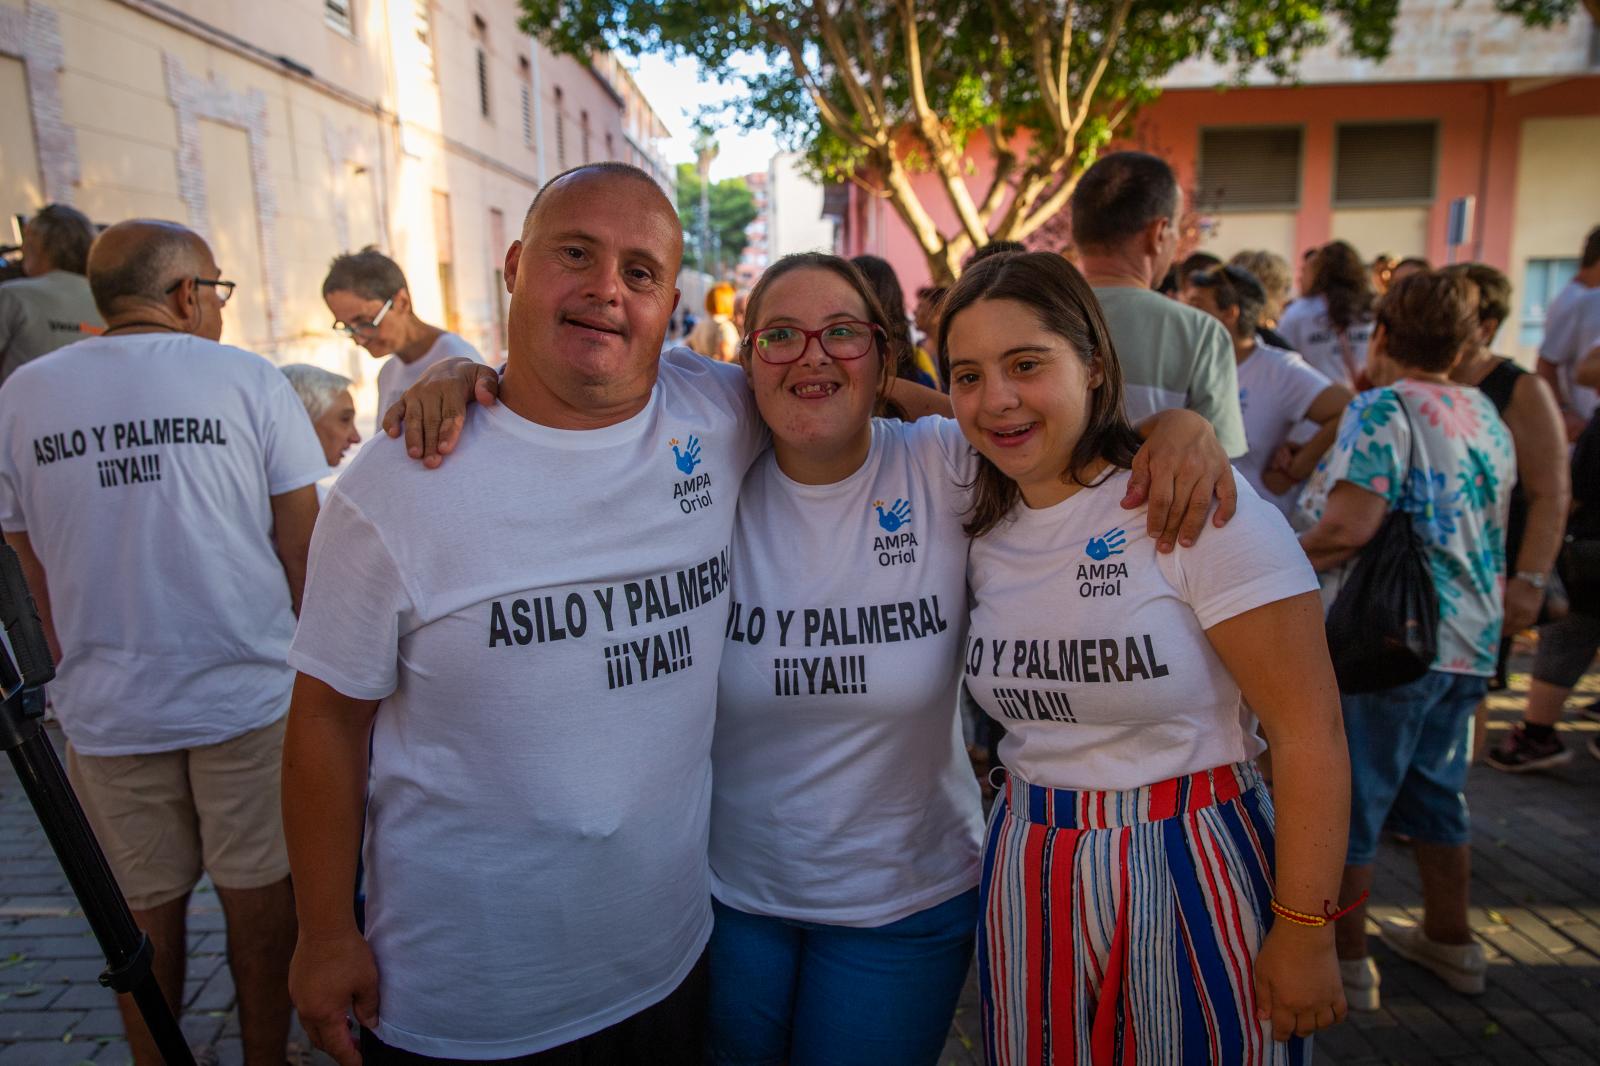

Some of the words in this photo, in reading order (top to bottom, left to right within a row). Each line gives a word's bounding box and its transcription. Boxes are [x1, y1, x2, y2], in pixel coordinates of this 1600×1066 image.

[34, 430, 86, 465] ASILO
[92, 426, 107, 452] Y
[113, 417, 226, 450] PALMERAL
[673, 472, 711, 499] AMPA
[679, 490, 713, 514] Oriol
[873, 533, 918, 551] AMPA
[878, 549, 916, 566] Oriol
[1076, 562, 1128, 580] AMPA
[1079, 580, 1121, 597] Oriol
[488, 592, 587, 648] ASILO
[593, 587, 614, 632] Y
[725, 601, 766, 646] ILO
[776, 610, 795, 647] Y
[803, 595, 948, 647] PALMERAL
[992, 639, 1007, 677] Y
[1012, 634, 1170, 683] PALMERAL
